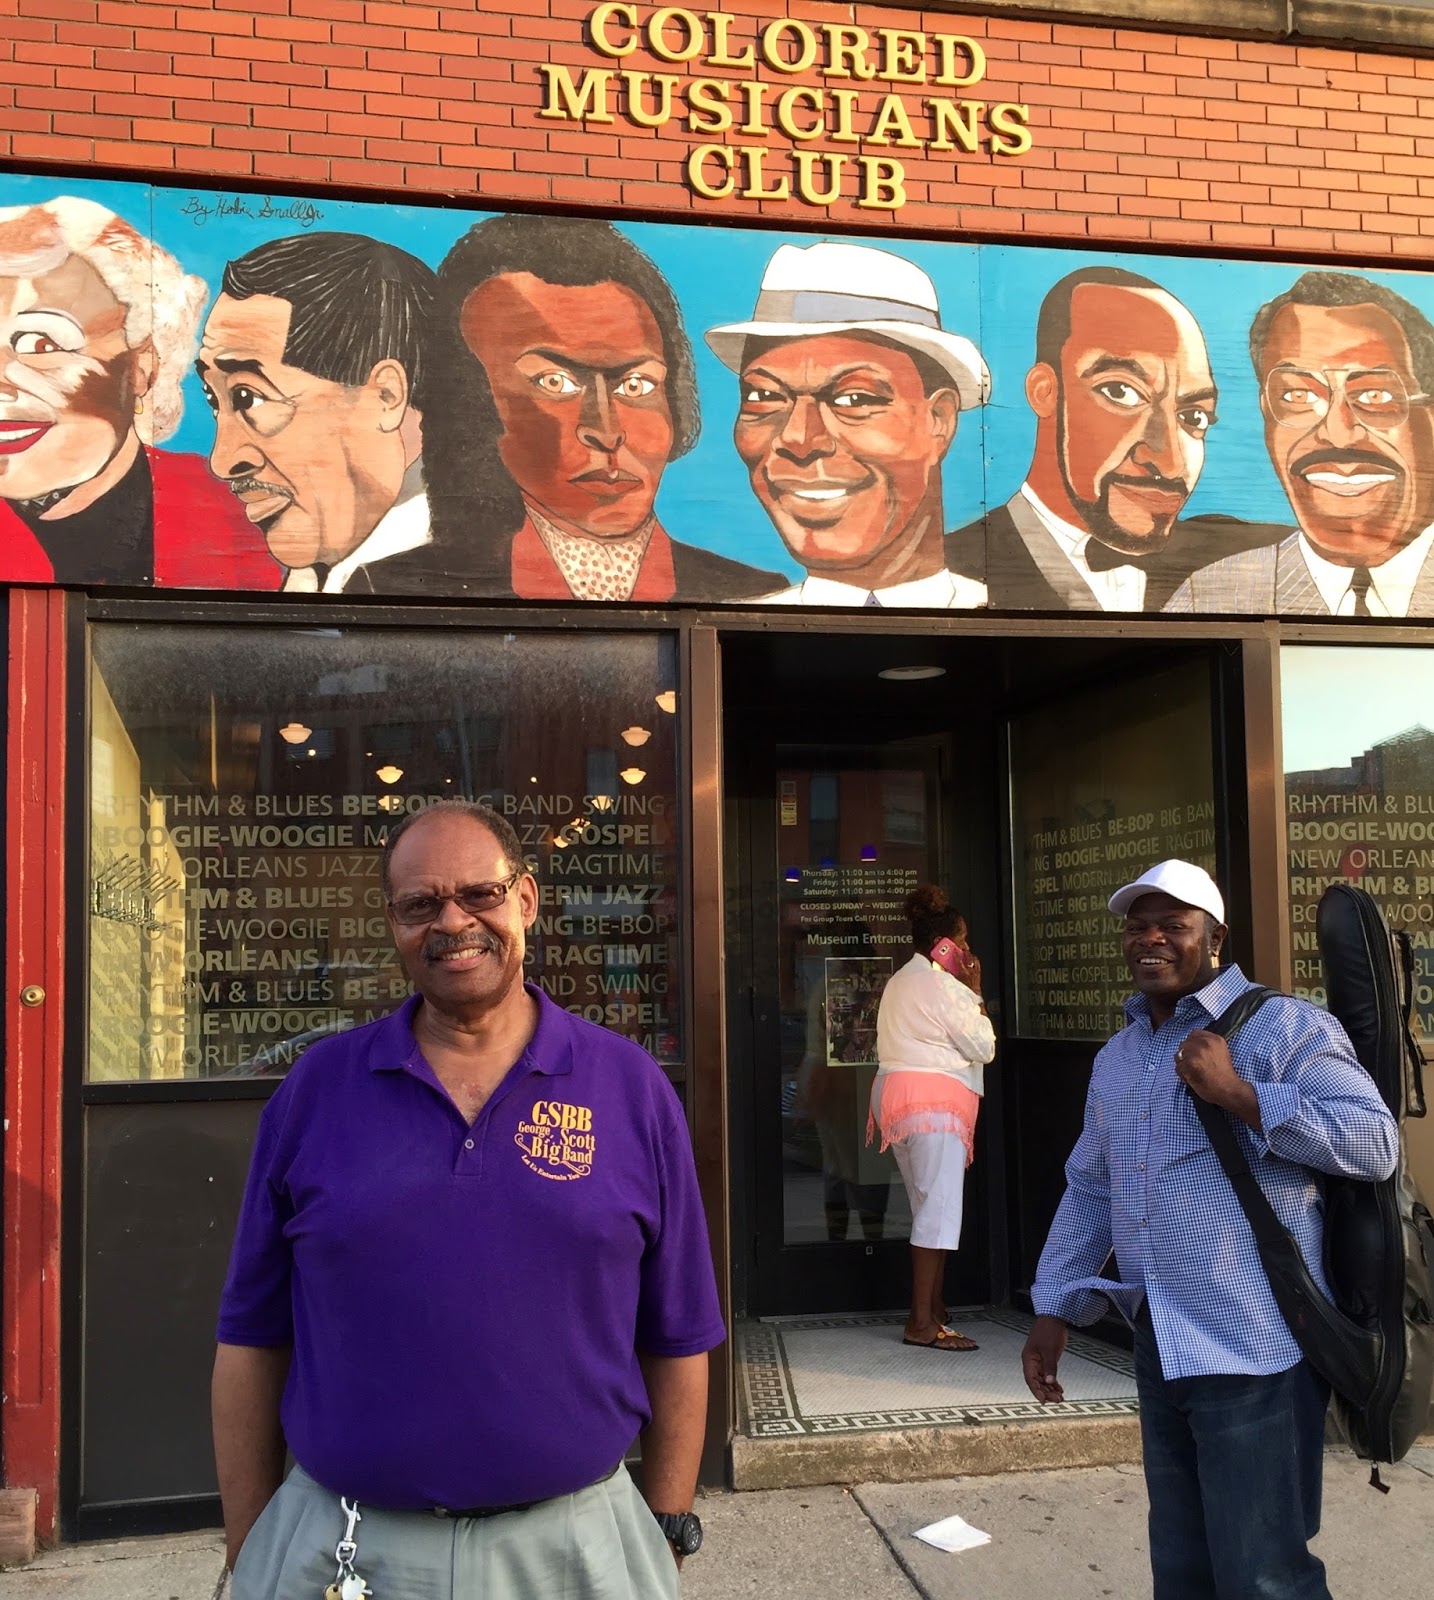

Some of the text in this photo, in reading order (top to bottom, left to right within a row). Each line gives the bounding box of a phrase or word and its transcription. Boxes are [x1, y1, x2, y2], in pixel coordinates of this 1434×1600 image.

[588, 2, 988, 88] COLORED
[538, 63, 1034, 156] MUSICIANS
[686, 143, 907, 211] CLUB
[181, 196, 213, 226] By
[102, 795, 219, 816] RHYTHM
[228, 795, 246, 817] &
[255, 795, 333, 816] BLUES
[503, 794, 574, 816] BAND
[582, 794, 665, 816] SWING
[1288, 794, 1378, 814] RHYTHM
[1384, 794, 1398, 814] &
[1060, 829, 1068, 845] &
[1070, 823, 1102, 844] BLUES
[1108, 812, 1154, 837] BE-BOP
[1160, 806, 1182, 825] BIG
[1187, 802, 1215, 824] BAN
[102, 825, 353, 848] BOOGIE-WOOGIE
[559, 824, 665, 846] GOSPEL
[1055, 836, 1160, 868] BOOGIE-WOOGIE
[1165, 828, 1215, 852] RAGTIM
[1291, 849, 1434, 868] NEW ORLEAN
[181, 856, 308, 879] ORLEANS
[316, 856, 380, 879] JAZZ
[550, 853, 665, 875] RAGTIME
[802, 869, 838, 877] Thursday:
[803, 888, 839, 896] Saturday:
[813, 879, 839, 887] Friday:
[905, 879, 917, 887] pm
[1033, 876, 1059, 894] SPEL
[1062, 868, 1113, 892] MODERN
[1393, 876, 1410, 895] &
[235, 887, 257, 909] &
[265, 887, 353, 909] BLUES
[539, 884, 593, 906] ERN
[602, 884, 665, 905] JAZZ
[832, 902, 865, 910] SUNDAY
[1067, 896, 1087, 914] BIG
[339, 917, 387, 938] BIG
[583, 915, 669, 936] BE-BOP
[1045, 919, 1099, 939] ORLEANS
[1102, 917, 1125, 935] JAZ
[807, 933, 914, 945] Museum Entrance
[183, 949, 320, 972] ORLEANS
[326, 948, 396, 970] JAZZ
[546, 944, 669, 966] RAGTIME
[1056, 944, 1078, 961] THE
[1080, 941, 1117, 959] BLUES
[1072, 966, 1113, 983] GOSPEL
[228, 981, 246, 1002] &
[256, 980, 334, 1002] BLUES
[585, 974, 669, 996] SWING
[1050, 989, 1100, 1006] ORLEANS
[1066, 1014, 1075, 1029] &
[1078, 1013, 1110, 1031] BLUES
[531, 1100, 593, 1132] GSBB
[518, 1121, 596, 1151] George Scott
[530, 1136, 593, 1166] Big Band
